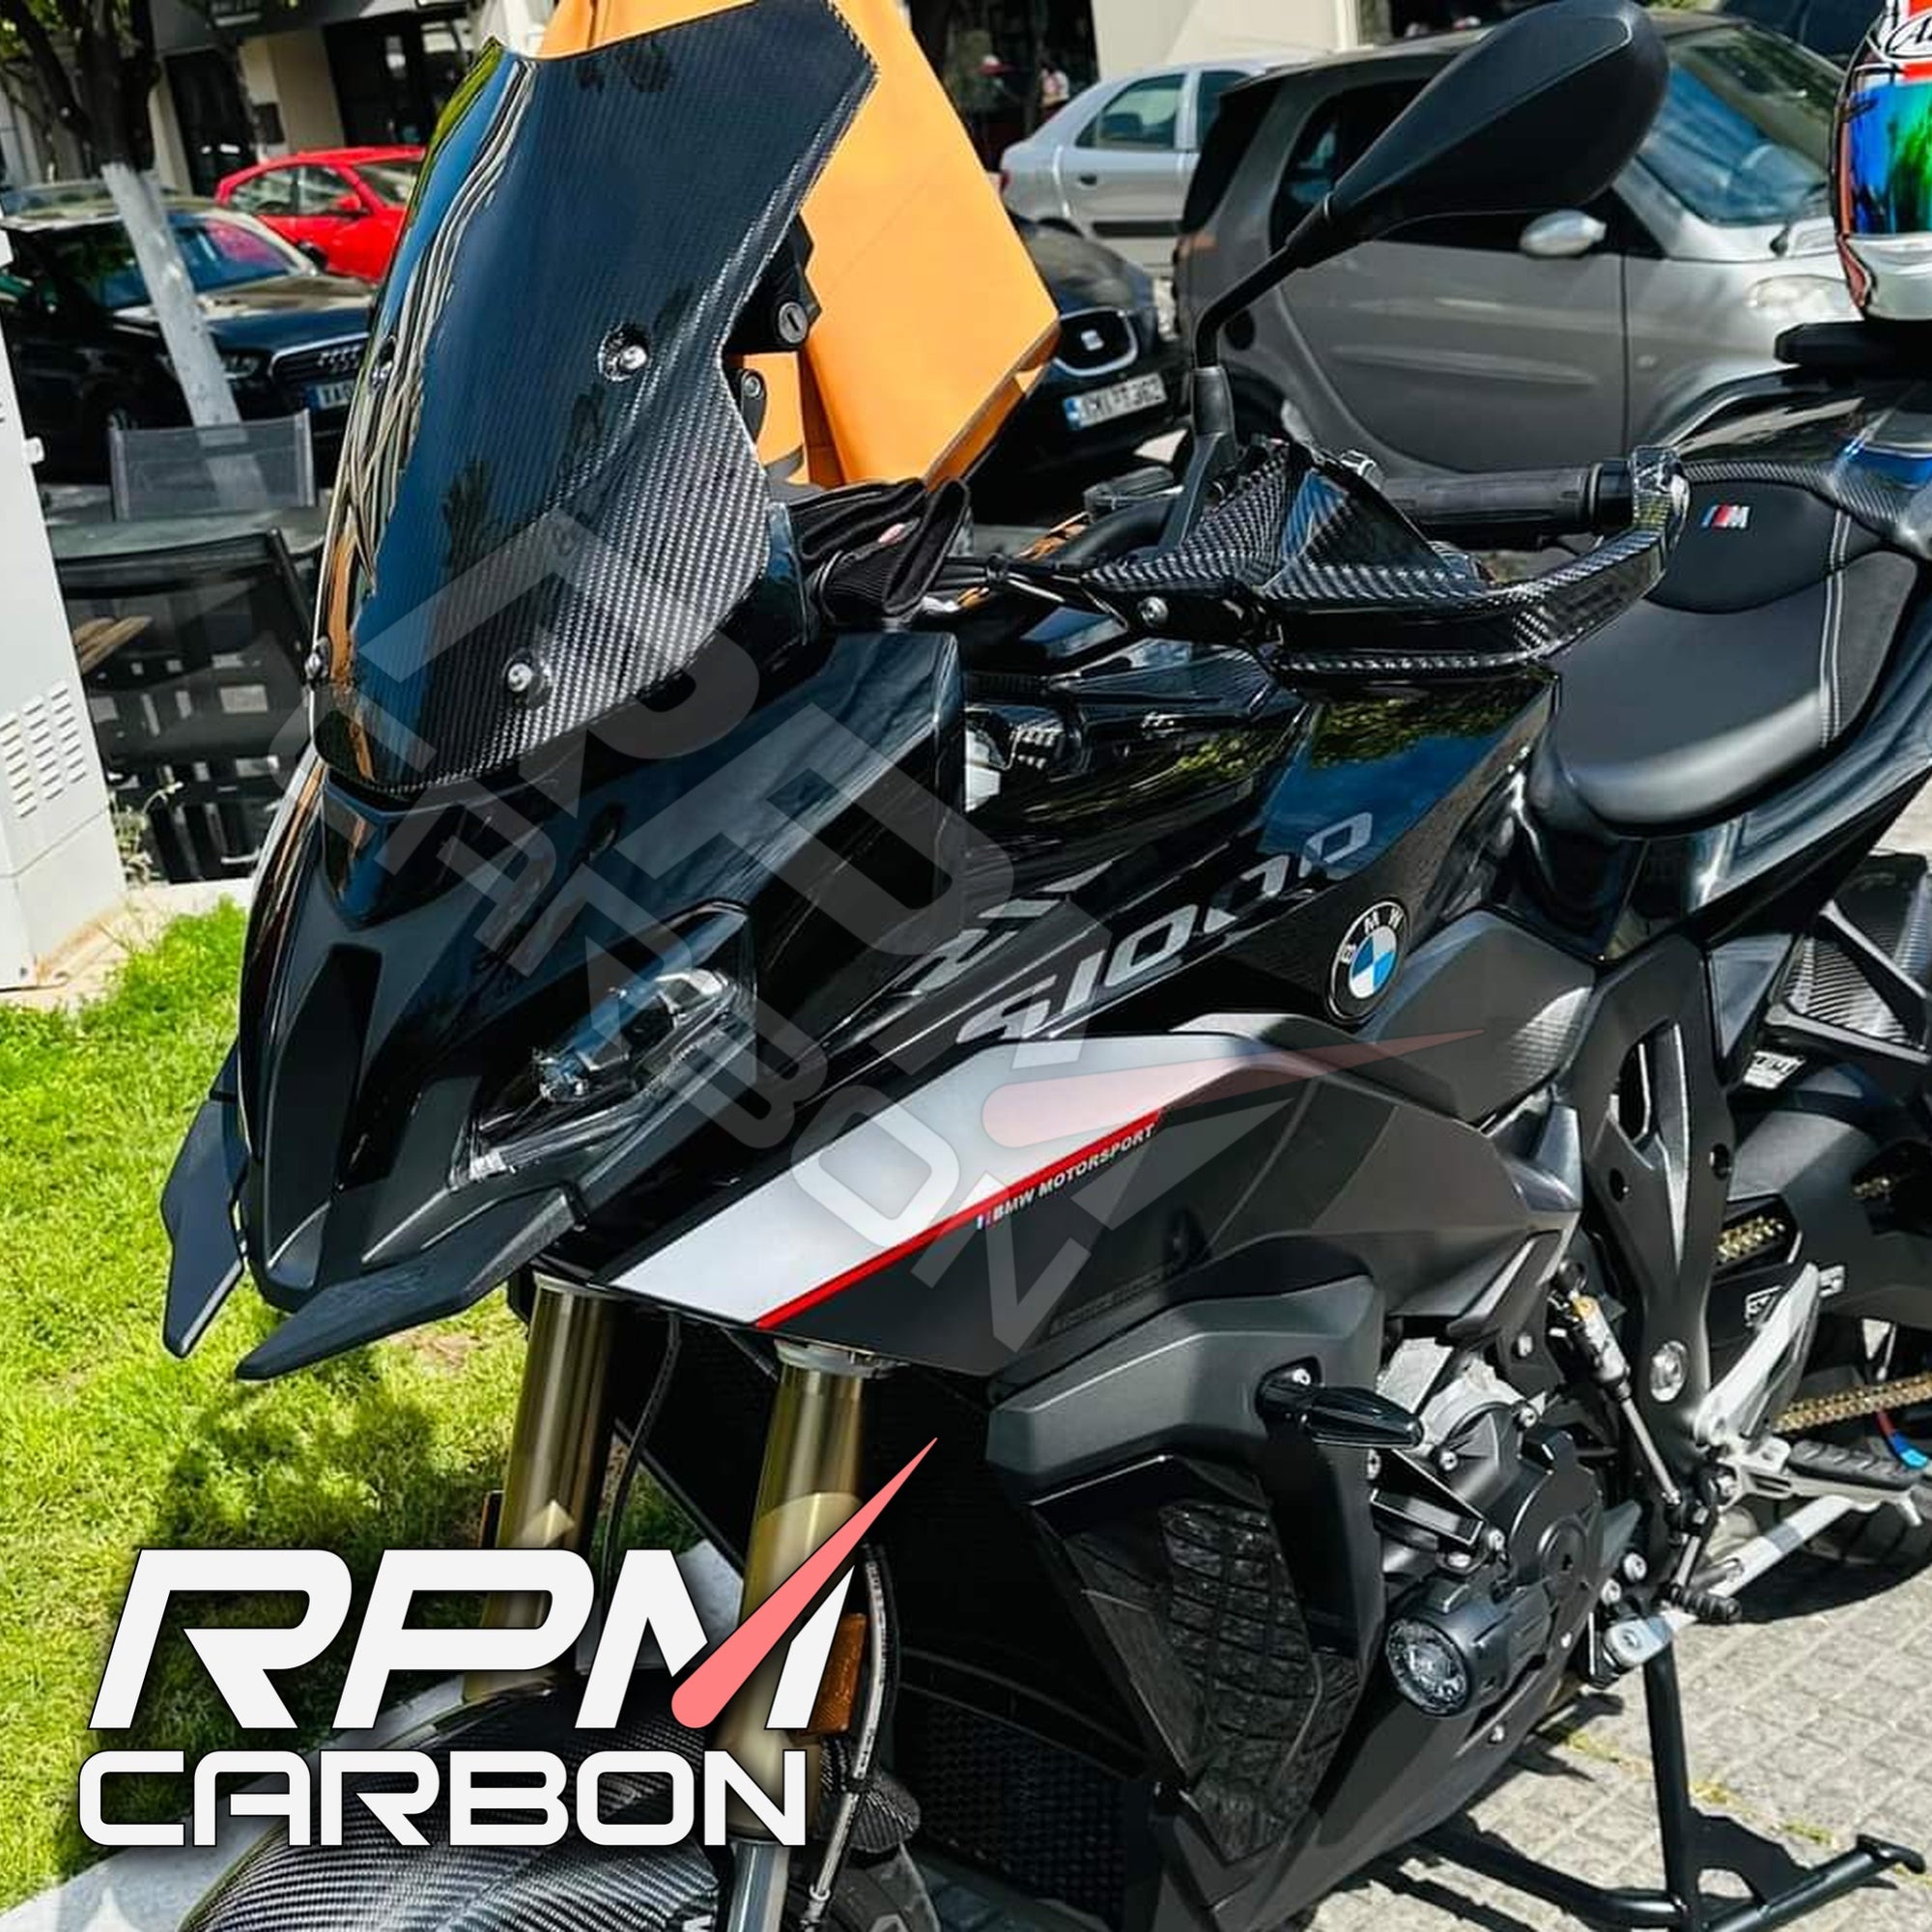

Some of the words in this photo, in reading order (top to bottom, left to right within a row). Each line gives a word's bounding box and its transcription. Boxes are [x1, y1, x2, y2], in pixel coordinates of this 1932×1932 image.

[1340, 907, 1405, 965] BMW
[992, 1189, 1036, 1222] BMW
[1038, 1123, 1155, 1198] MOTORSPORT
